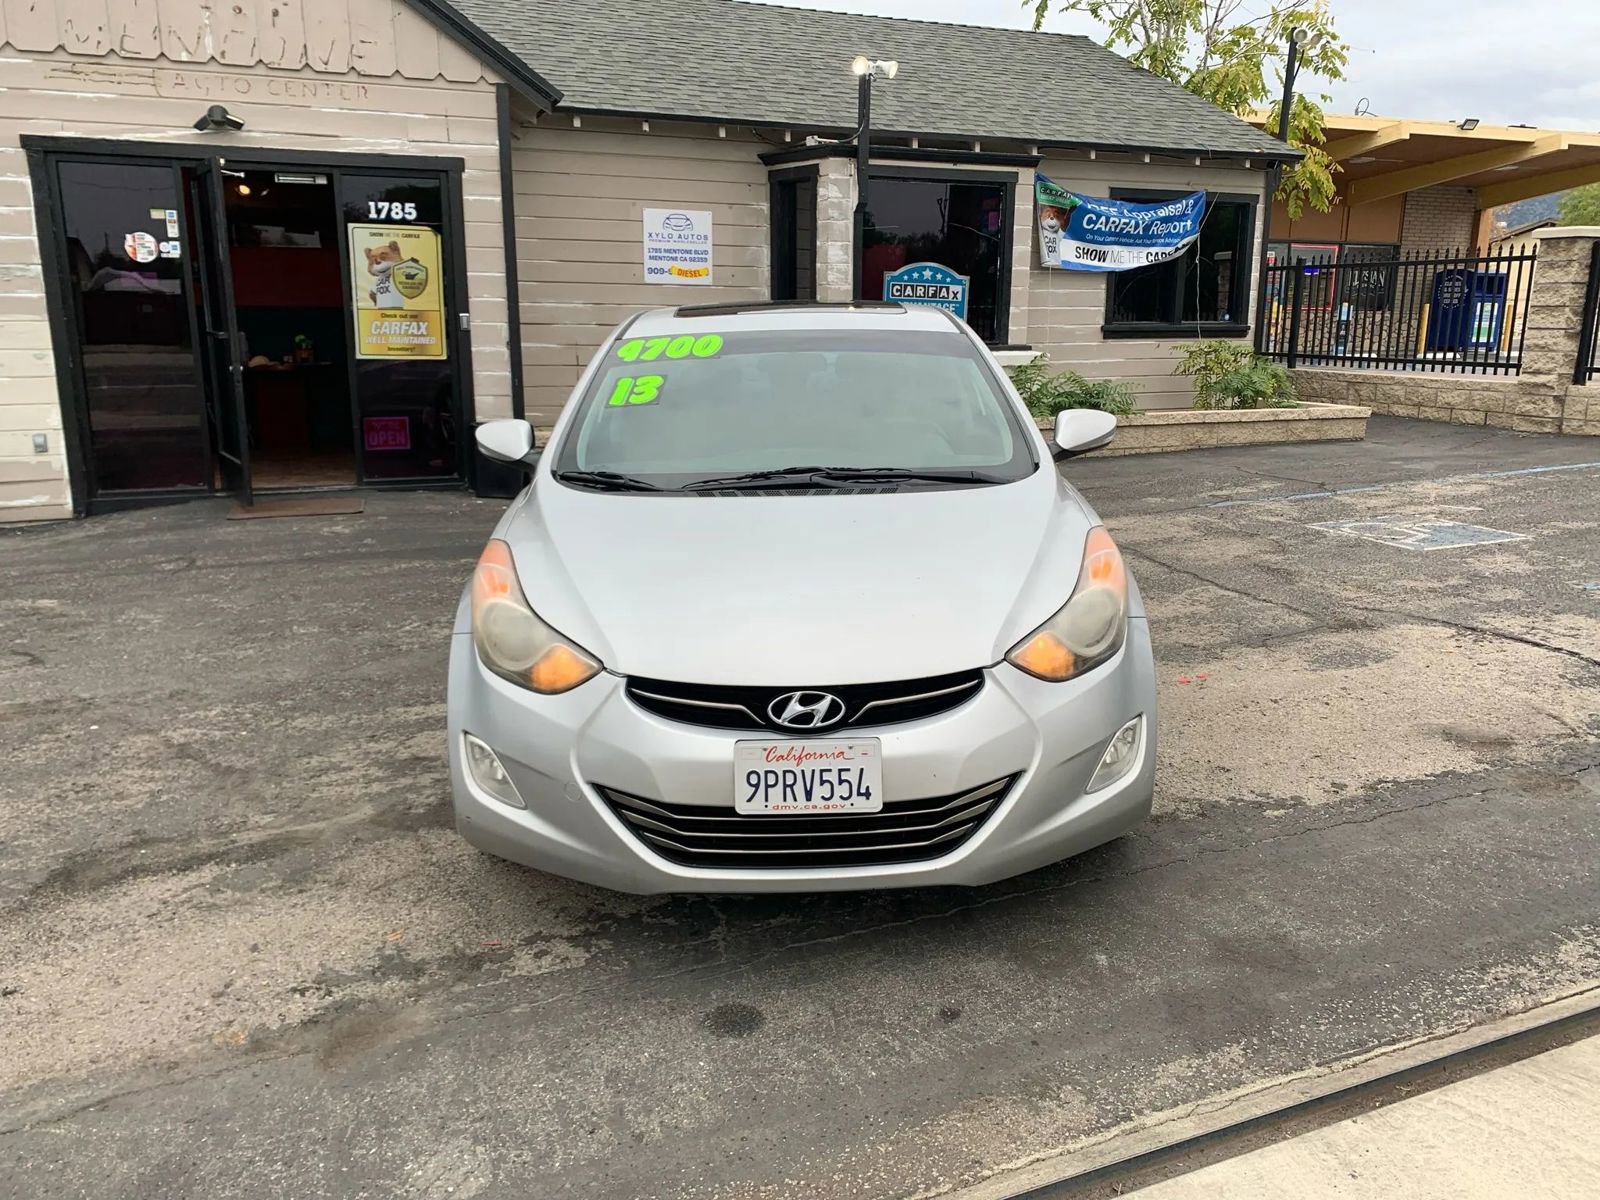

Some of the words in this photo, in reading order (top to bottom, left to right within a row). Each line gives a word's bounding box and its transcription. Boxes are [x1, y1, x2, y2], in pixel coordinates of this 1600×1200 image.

[368, 202, 417, 220] 1785
[1083, 214, 1147, 235] CARFAX
[1149, 219, 1192, 236] Report
[648, 232, 673, 240] XYLO
[1075, 246, 1109, 263] SHOW
[1110, 250, 1124, 264] ME
[1127, 250, 1144, 264] THE
[677, 268, 702, 278] DIESEL
[893, 285, 959, 300] CARFAX
[371, 321, 428, 335] CARFAX
[617, 335, 724, 361] 4700
[609, 375, 665, 406] 13
[369, 431, 405, 446] OPEN
[765, 746, 855, 766] California
[746, 768, 872, 803] 9PRV554
[772, 803, 846, 812] dmv.ca.gov
